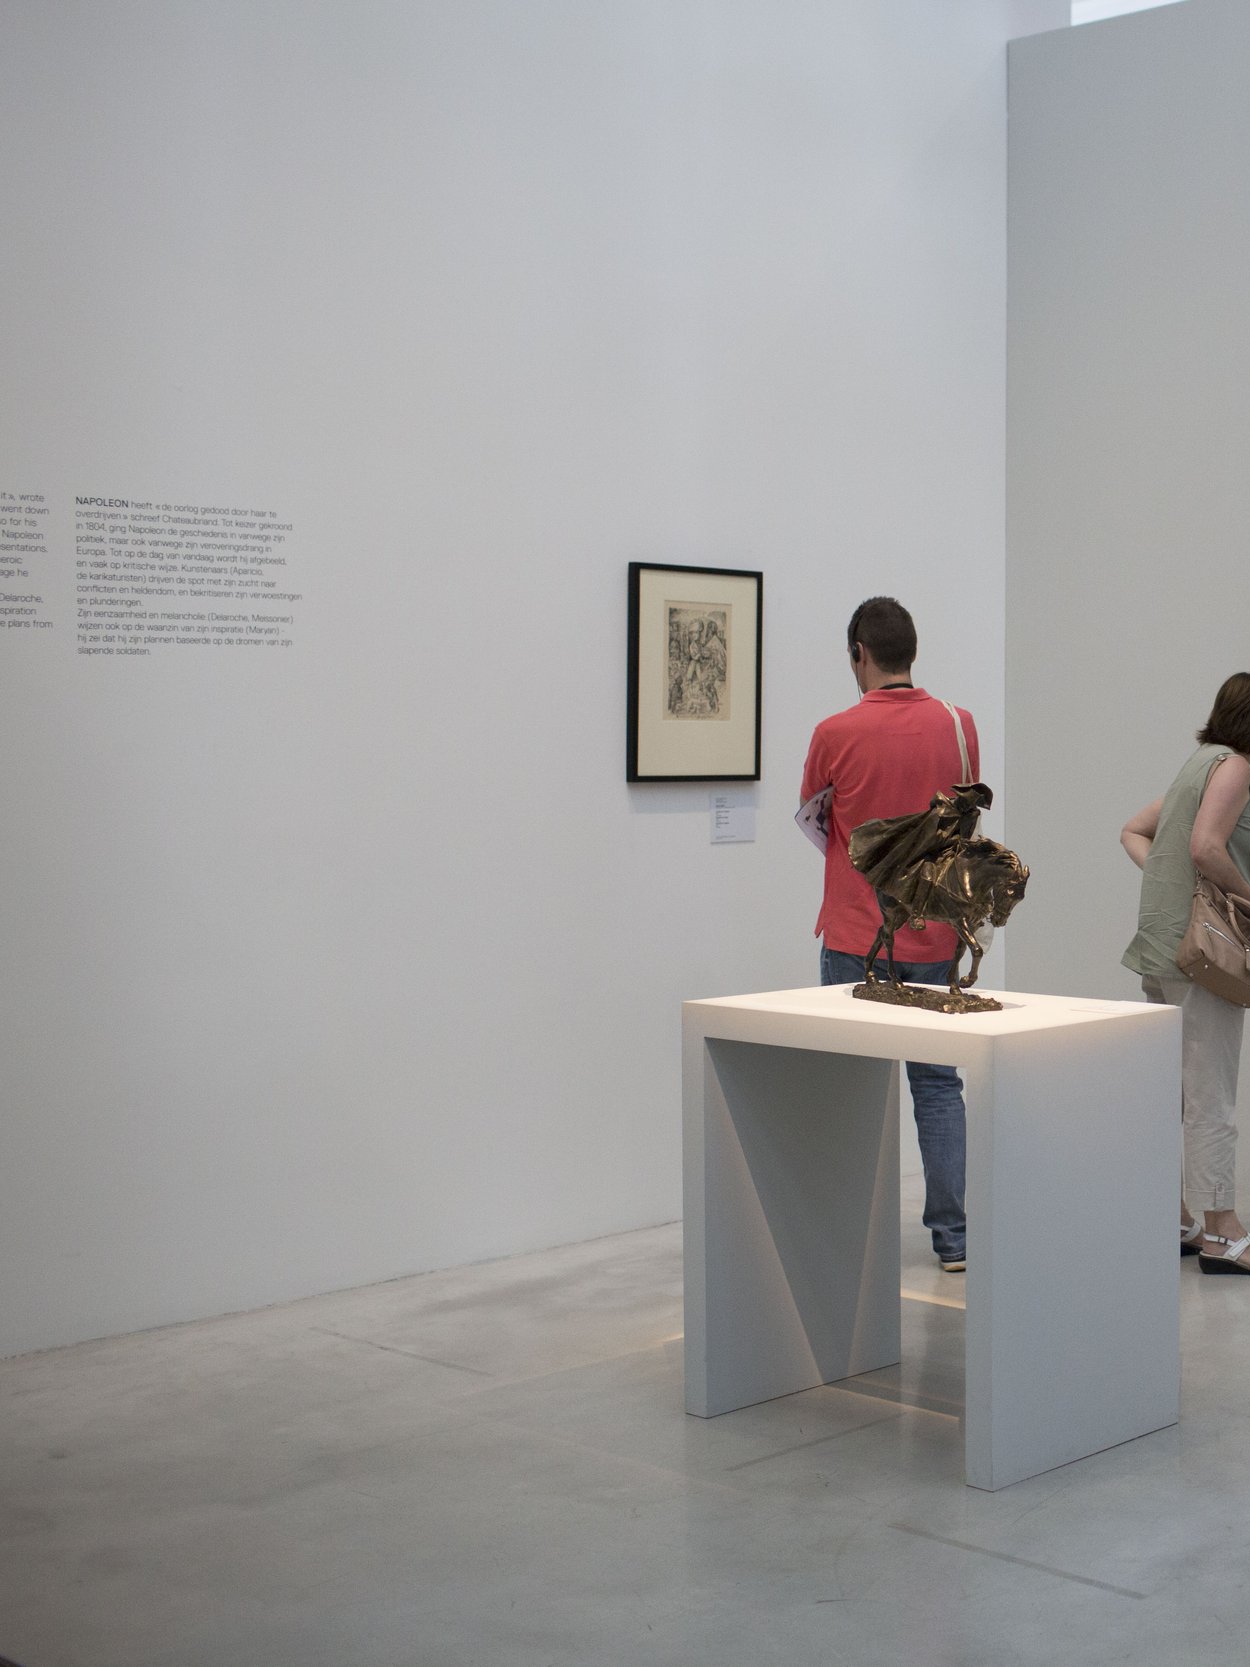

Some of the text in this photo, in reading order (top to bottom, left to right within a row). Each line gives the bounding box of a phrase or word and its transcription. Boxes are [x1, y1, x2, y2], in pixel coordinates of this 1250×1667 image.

[19, 494, 44, 502] wrote
[76, 497, 128, 508] NAPOLEON
[174, 504, 198, 514] oorlog
[201, 507, 229, 515] gedood
[251, 509, 266, 517] haar
[10, 518, 21, 526] for
[25, 519, 37, 527] his
[131, 514, 159, 522] schreef
[222, 519, 233, 527] Tot
[235, 520, 256, 528] keizer
[259, 523, 292, 531] gekroond
[2, 530, 43, 540] Napoleon
[109, 525, 126, 534] ging
[129, 525, 166, 534] Napoleon
[180, 528, 228, 538] geschiedenis
[149, 540, 183, 550] vanwege
[200, 544, 263, 553] veroveringsdrang
[110, 548, 122, 556] Tot
[125, 550, 135, 558] op
[149, 551, 163, 560] dag
[166, 551, 180, 559] van
[182, 554, 214, 563] vandaag
[240, 556, 248, 564] hij
[17, 568, 28, 577] he
[110, 562, 120, 570] op
[123, 562, 156, 570] kritische
[182, 564, 228, 574] Kunstenaars
[149, 576, 174, 584] drijven
[188, 578, 204, 587] spot
[224, 579, 236, 587] zijn
[178, 589, 188, 597] en
[190, 589, 233, 597] bekritiseren
[235, 592, 247, 600] zijn
[251, 592, 302, 602] verwoestingen
[77, 608, 91, 617] Zijn
[94, 610, 147, 619] eenzaamheid
[160, 612, 206, 620] melancholie
[8, 620, 30, 629] plans
[33, 620, 53, 628] from
[105, 622, 120, 630] ook
[122, 624, 132, 632] op
[78, 635, 86, 643] hij
[118, 635, 126, 644] hij
[129, 636, 141, 644] zijn
[144, 636, 174, 644] plannen
[176, 635, 211, 644] baseerde
[213, 638, 222, 646] op
[280, 639, 292, 648] zijn
[78, 647, 114, 655] slapende
